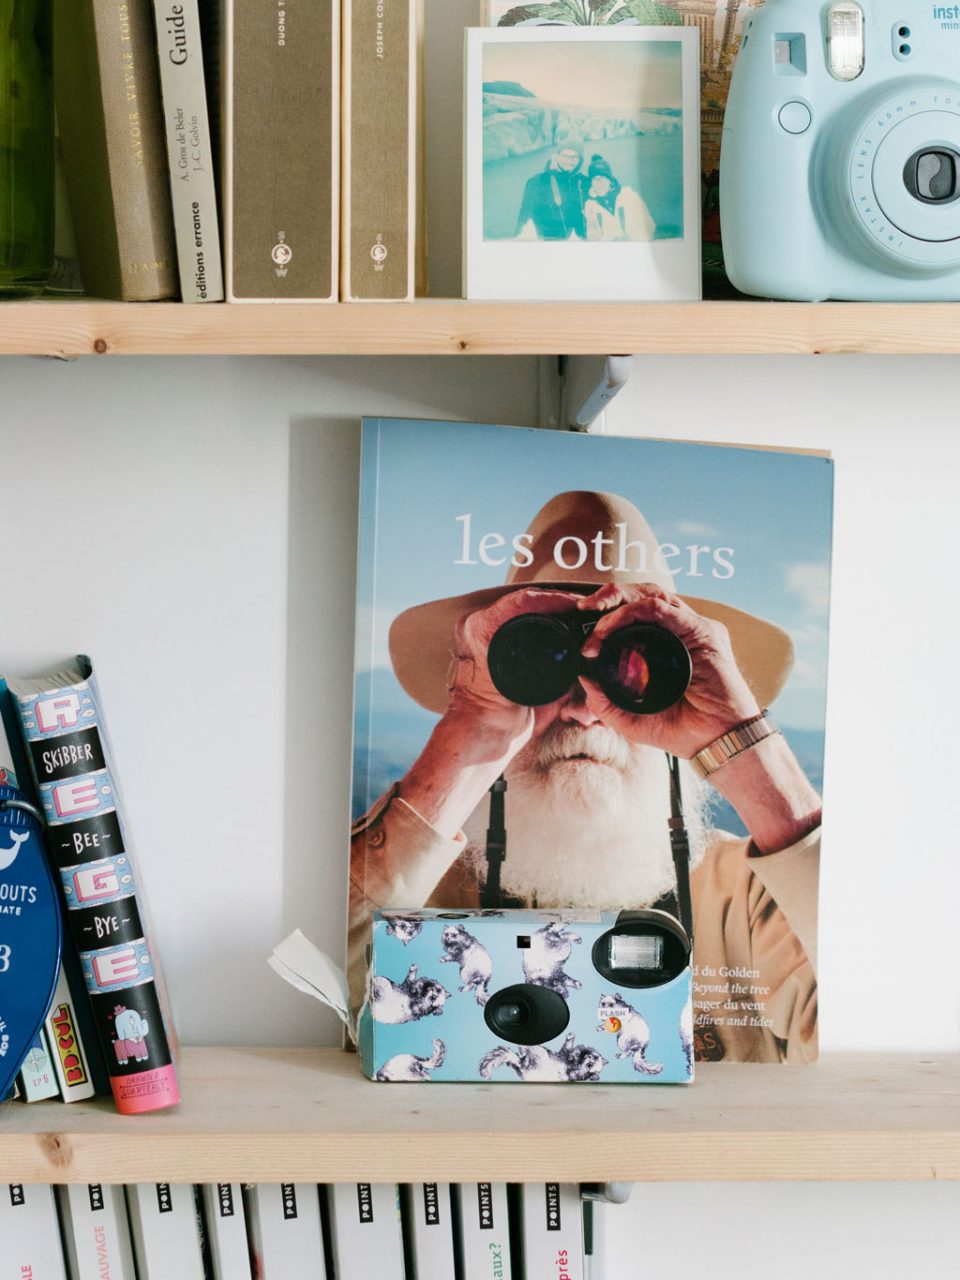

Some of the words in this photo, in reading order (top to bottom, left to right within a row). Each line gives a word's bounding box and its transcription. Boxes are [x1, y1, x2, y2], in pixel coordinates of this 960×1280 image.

[933, 5, 960, 19] inst
[166, 6, 187, 65] Guide
[192, 202, 202, 247] errance
[195, 252, 207, 299] éditions
[454, 514, 534, 567] les
[553, 522, 735, 579] others
[732, 983, 748, 993] the
[750, 985, 769, 994] tree
[481, 1184, 490, 1224] POINTS
[549, 1186, 557, 1226] POINTS
